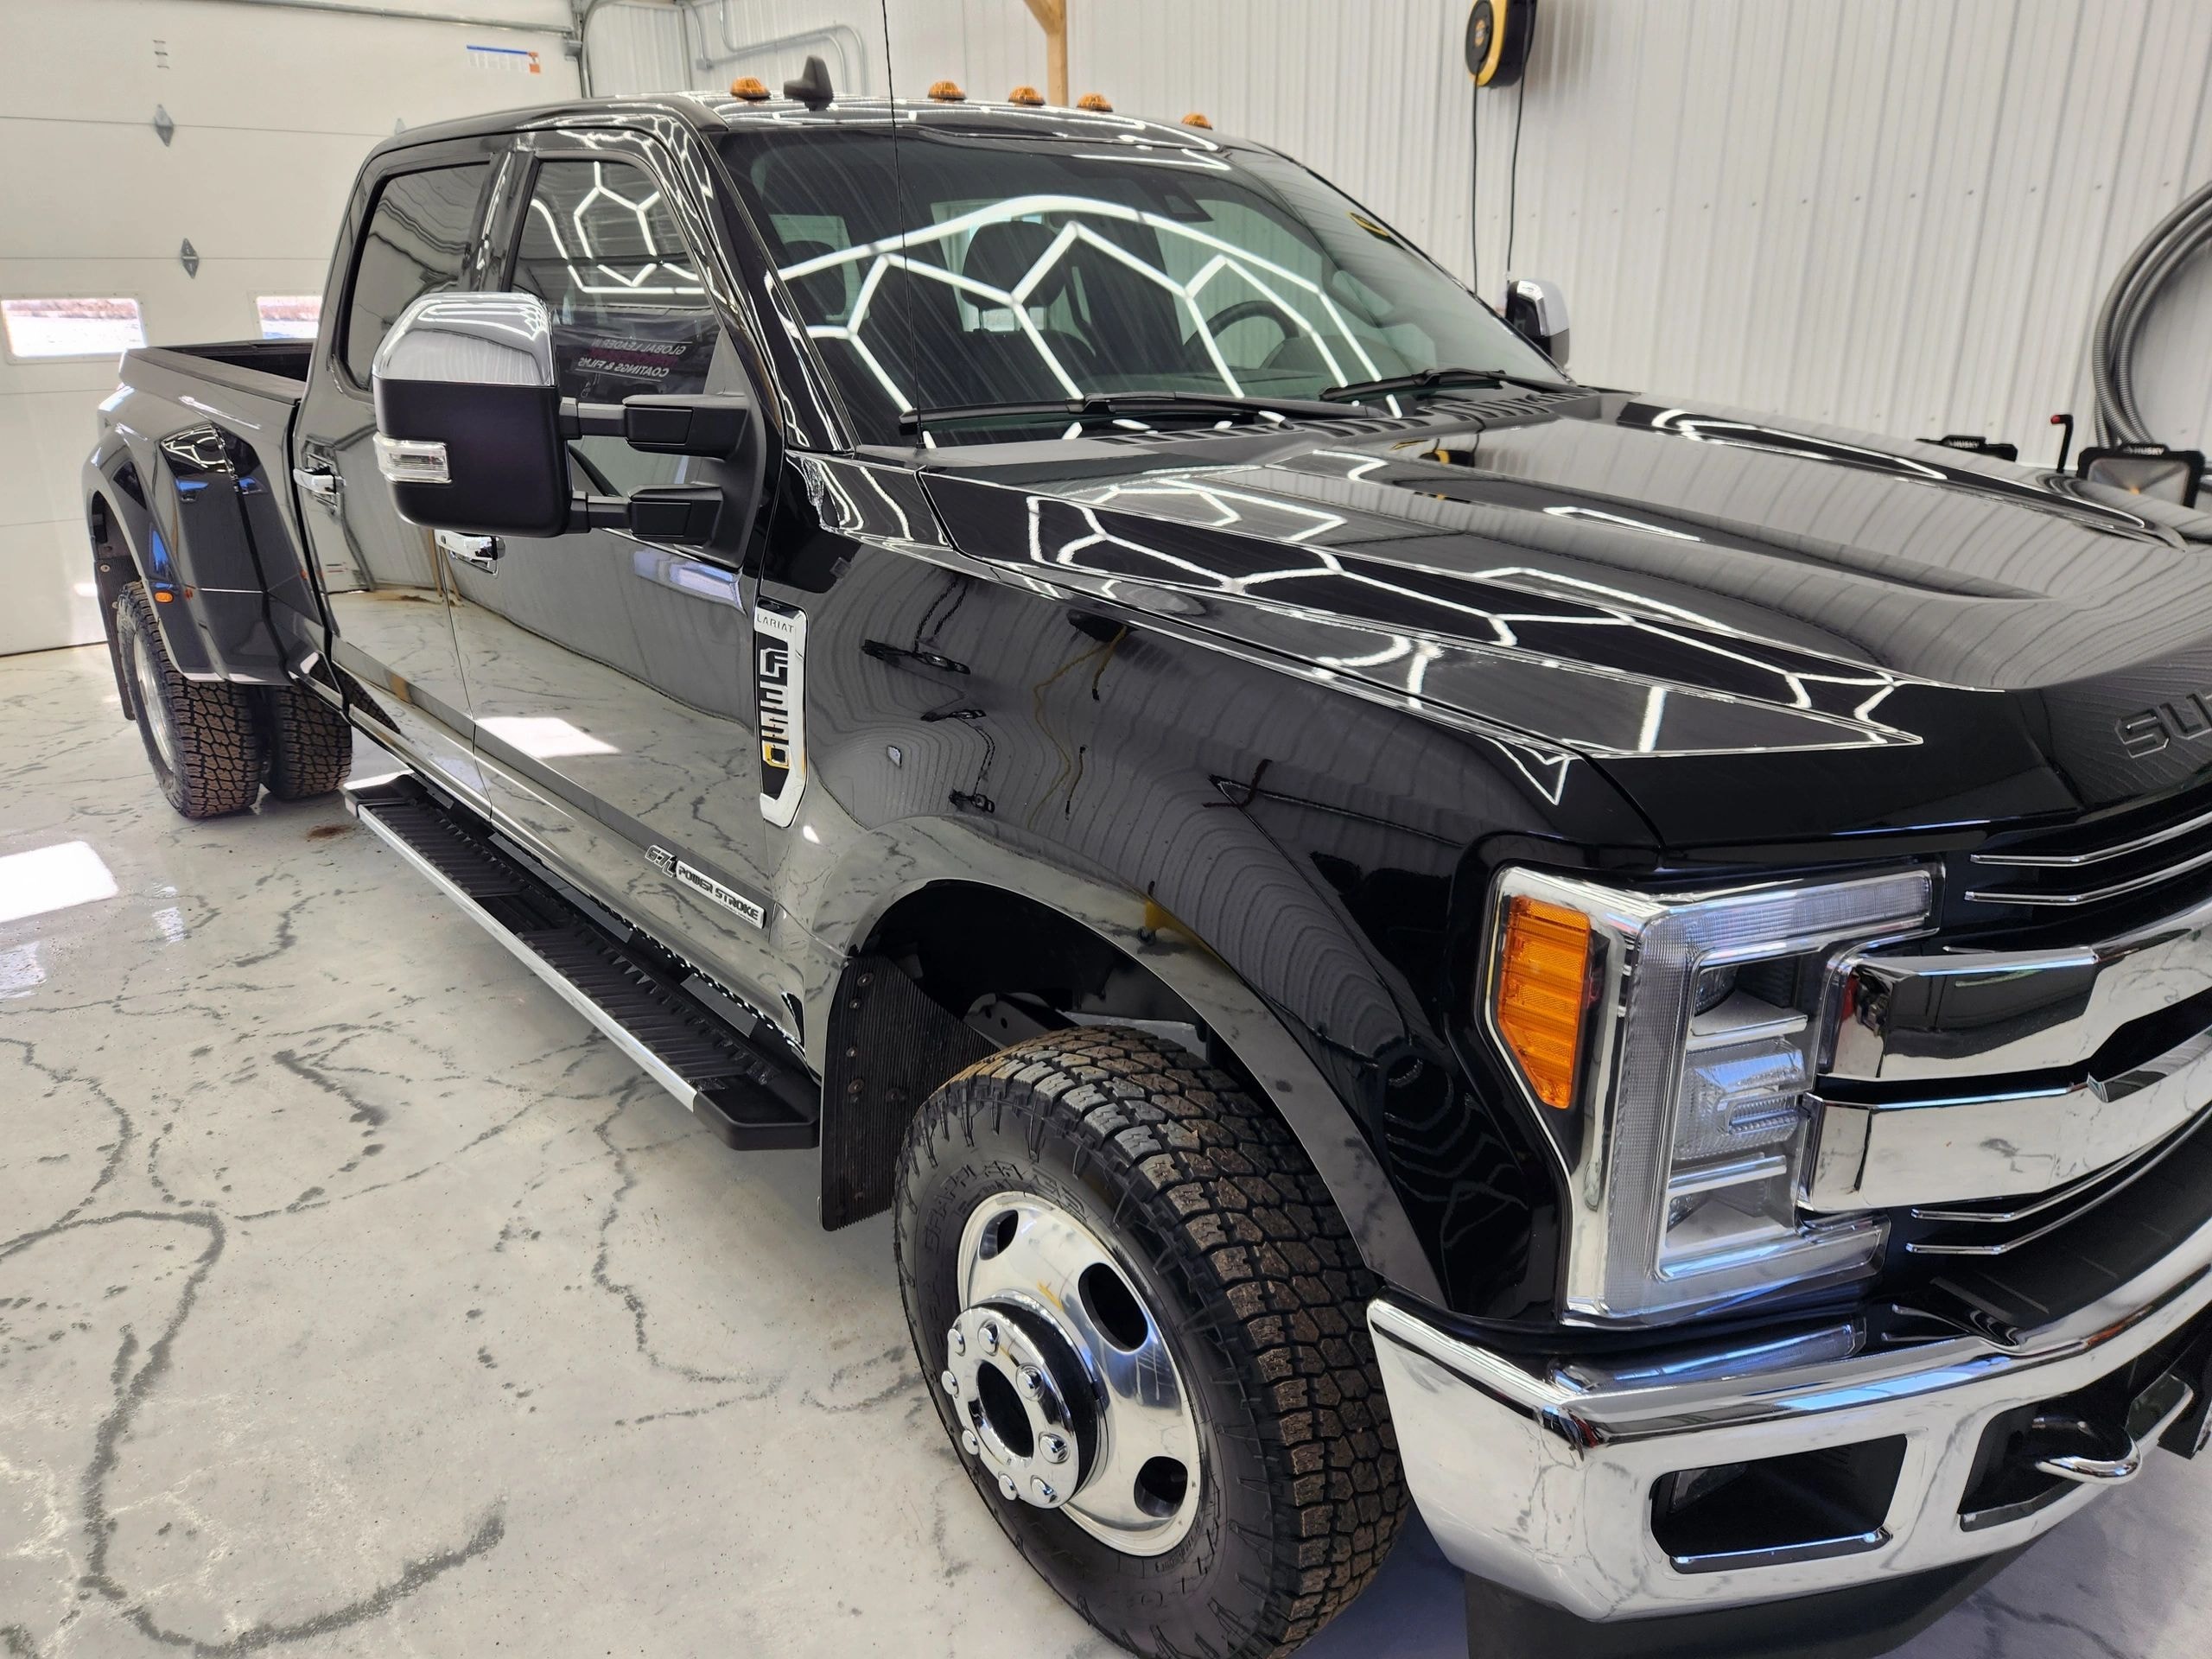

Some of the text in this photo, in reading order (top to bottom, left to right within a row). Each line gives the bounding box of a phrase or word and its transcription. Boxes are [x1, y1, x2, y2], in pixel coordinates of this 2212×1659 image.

[1952, 439, 1980, 448] HUSKY
[2133, 446, 2164, 455] HUSKY
[756, 613, 794, 633] LARIAT
[2114, 690, 2212, 759] SU
[678, 865, 714, 894] POWER
[715, 887, 760, 921] STROKE
